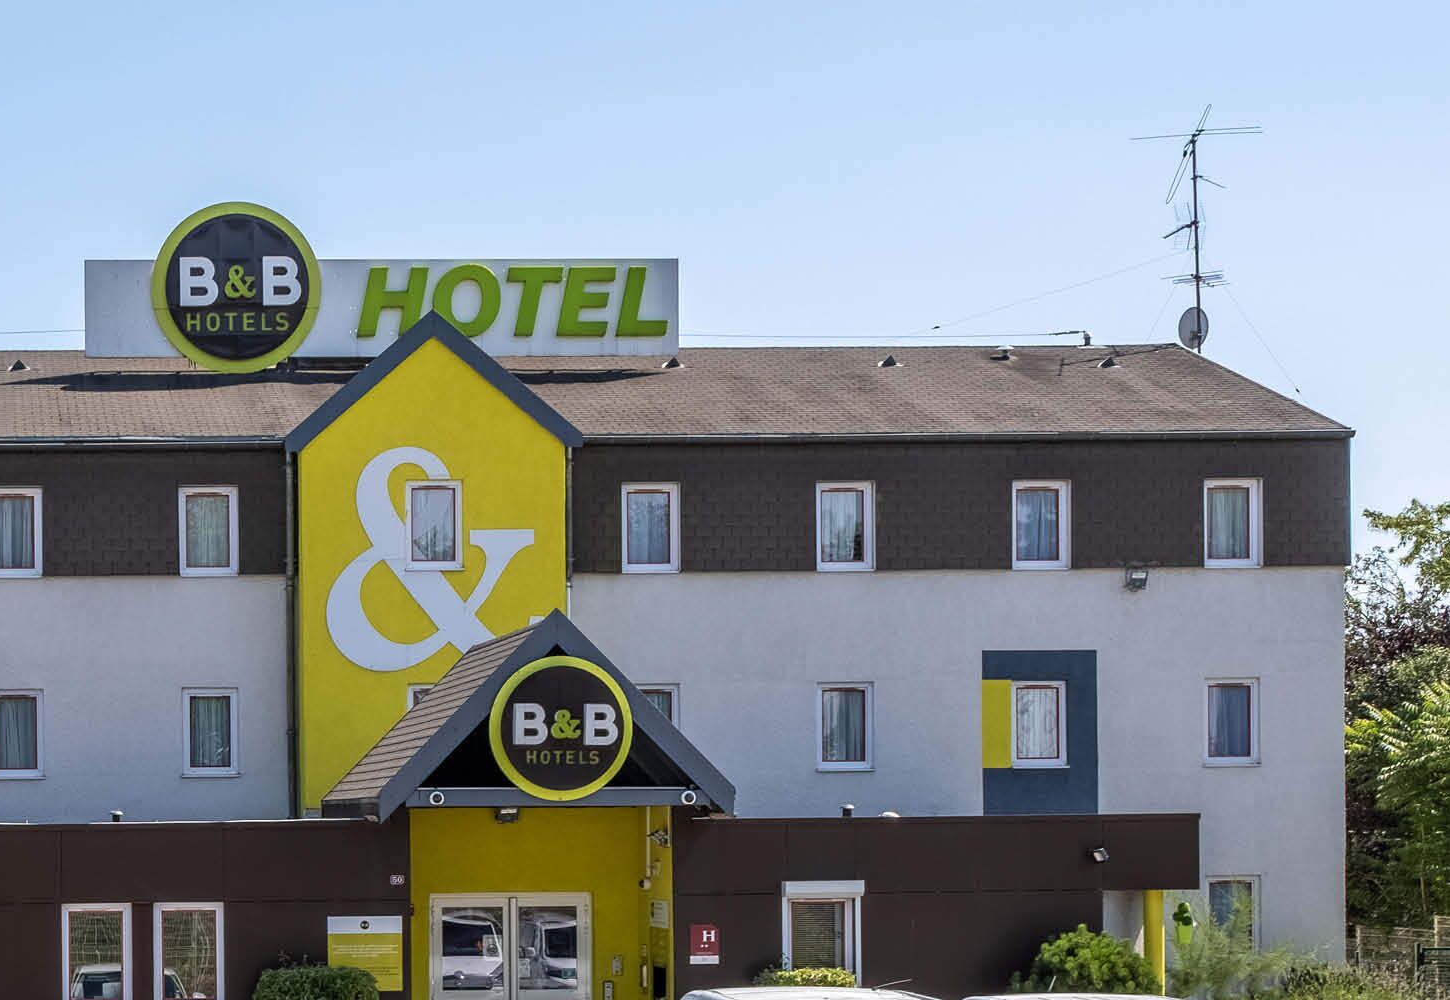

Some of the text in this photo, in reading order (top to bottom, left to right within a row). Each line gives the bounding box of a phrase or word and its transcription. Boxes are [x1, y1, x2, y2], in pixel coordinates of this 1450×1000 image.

[179, 256, 302, 307] B&B
[356, 263, 669, 338] HOTEL
[186, 312, 290, 332] HOTELS
[326, 446, 535, 671] &
[512, 703, 619, 746] B&B
[526, 751, 601, 765] HOTELS
[703, 930, 716, 942] H
